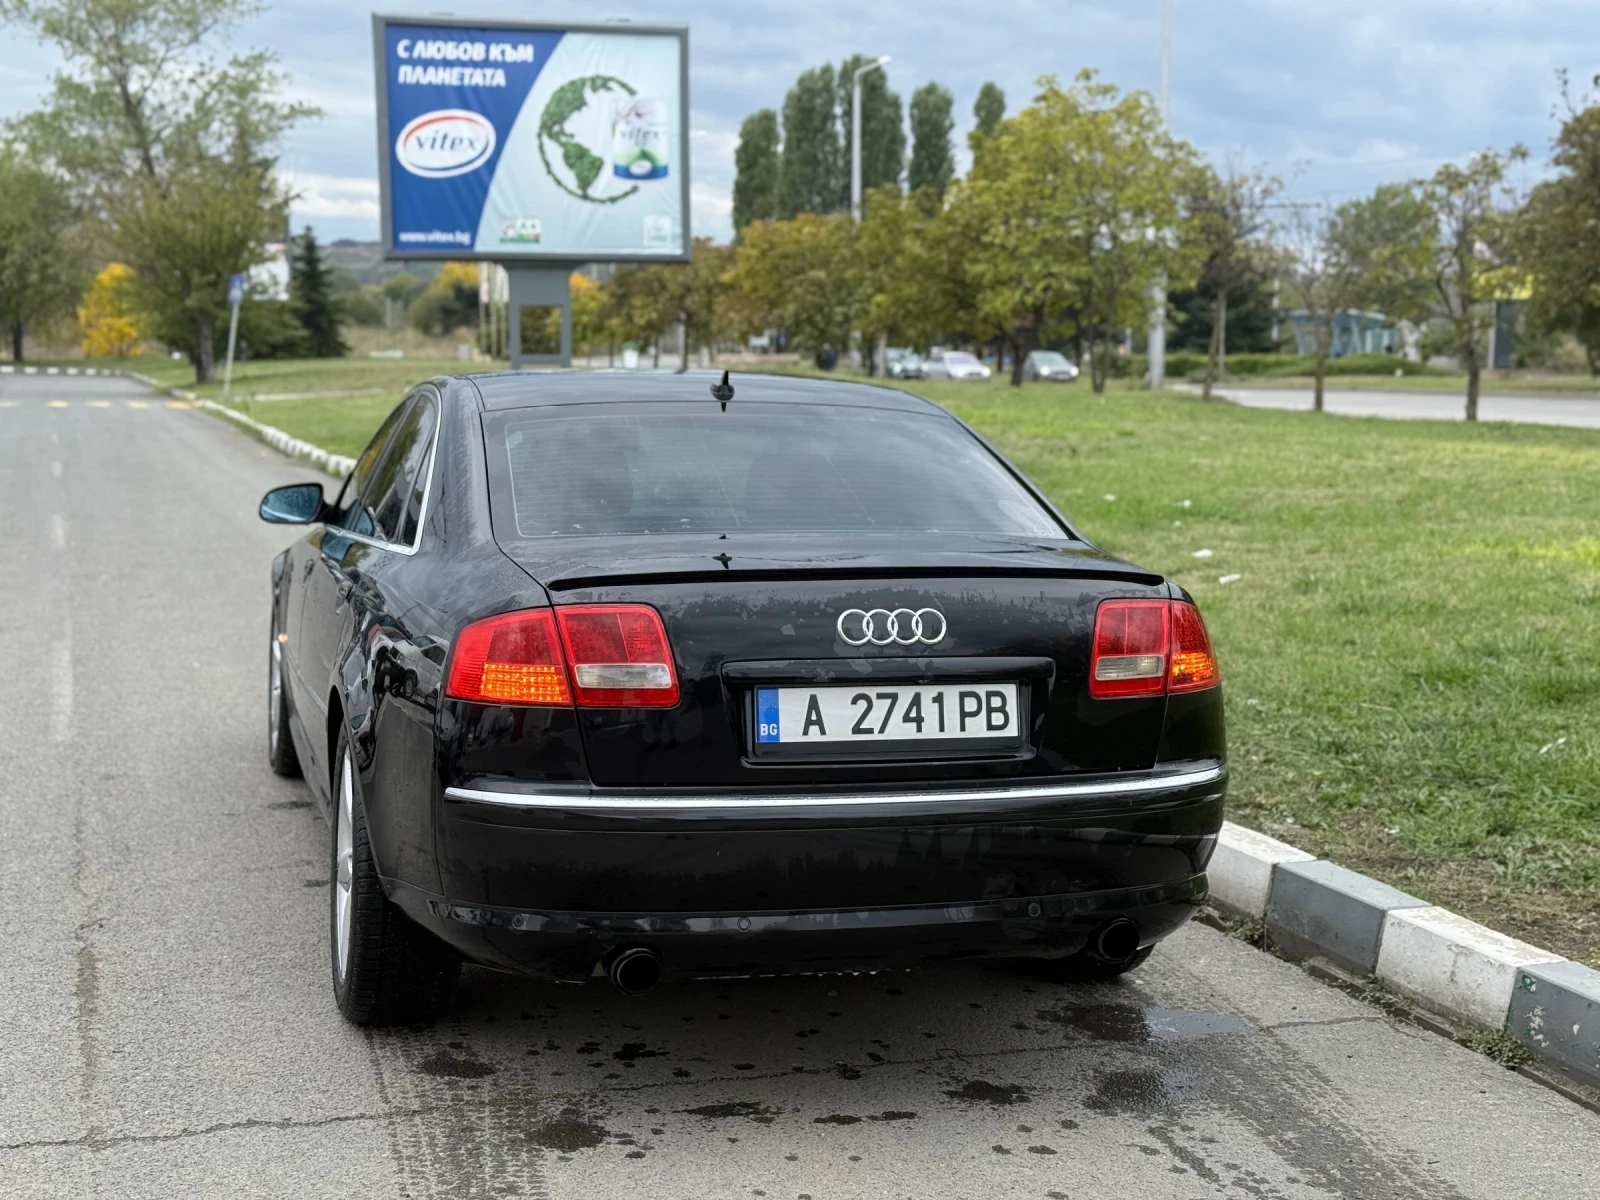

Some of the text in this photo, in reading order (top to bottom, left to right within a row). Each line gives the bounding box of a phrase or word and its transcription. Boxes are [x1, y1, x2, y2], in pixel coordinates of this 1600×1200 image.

[397, 38, 534, 63] С ЛЮБОВ КЪМ
[398, 65, 506, 87] ПЛАНЕТАТА
[416, 129, 478, 151] vitex
[802, 694, 827, 736] A
[760, 723, 778, 736] BG
